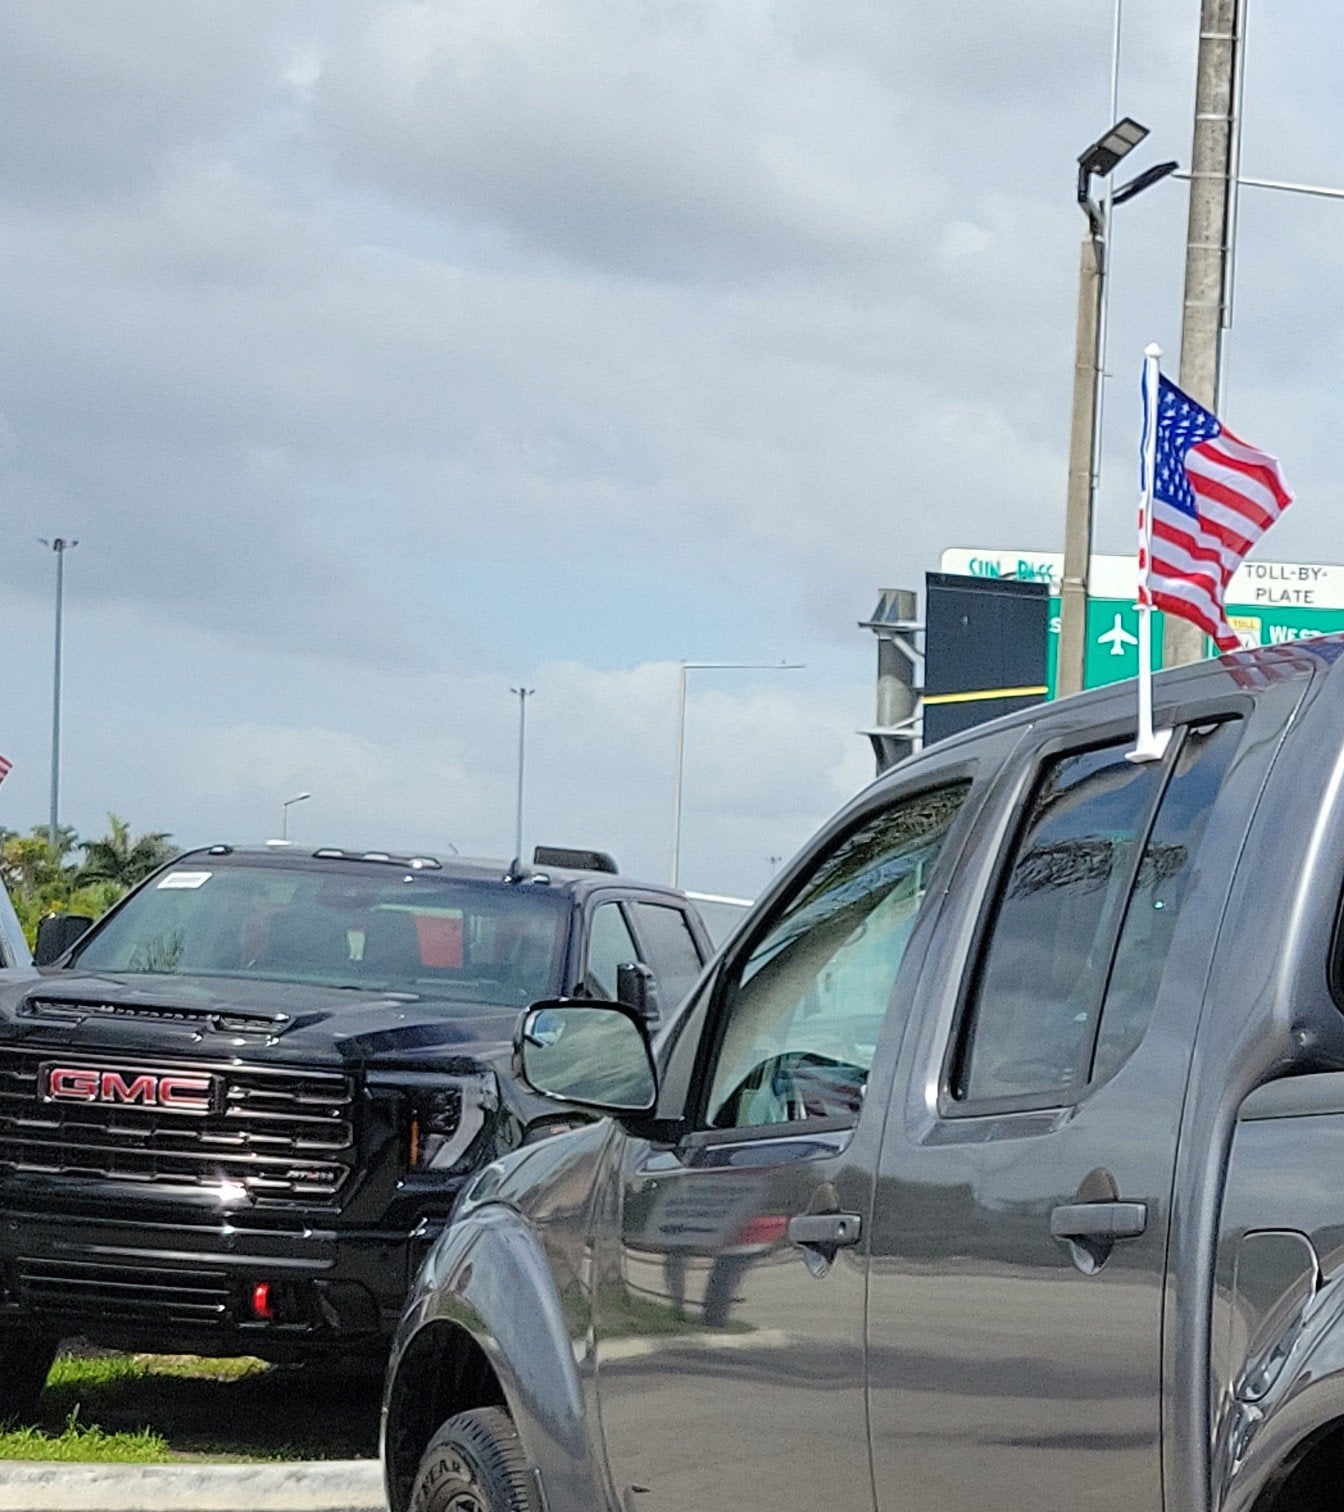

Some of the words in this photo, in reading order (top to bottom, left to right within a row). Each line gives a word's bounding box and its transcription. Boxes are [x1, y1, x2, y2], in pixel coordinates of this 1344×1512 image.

[1245, 564, 1328, 581] TOLL-BY-
[1256, 587, 1315, 604] PLATE
[50, 1067, 211, 1110] GMC
